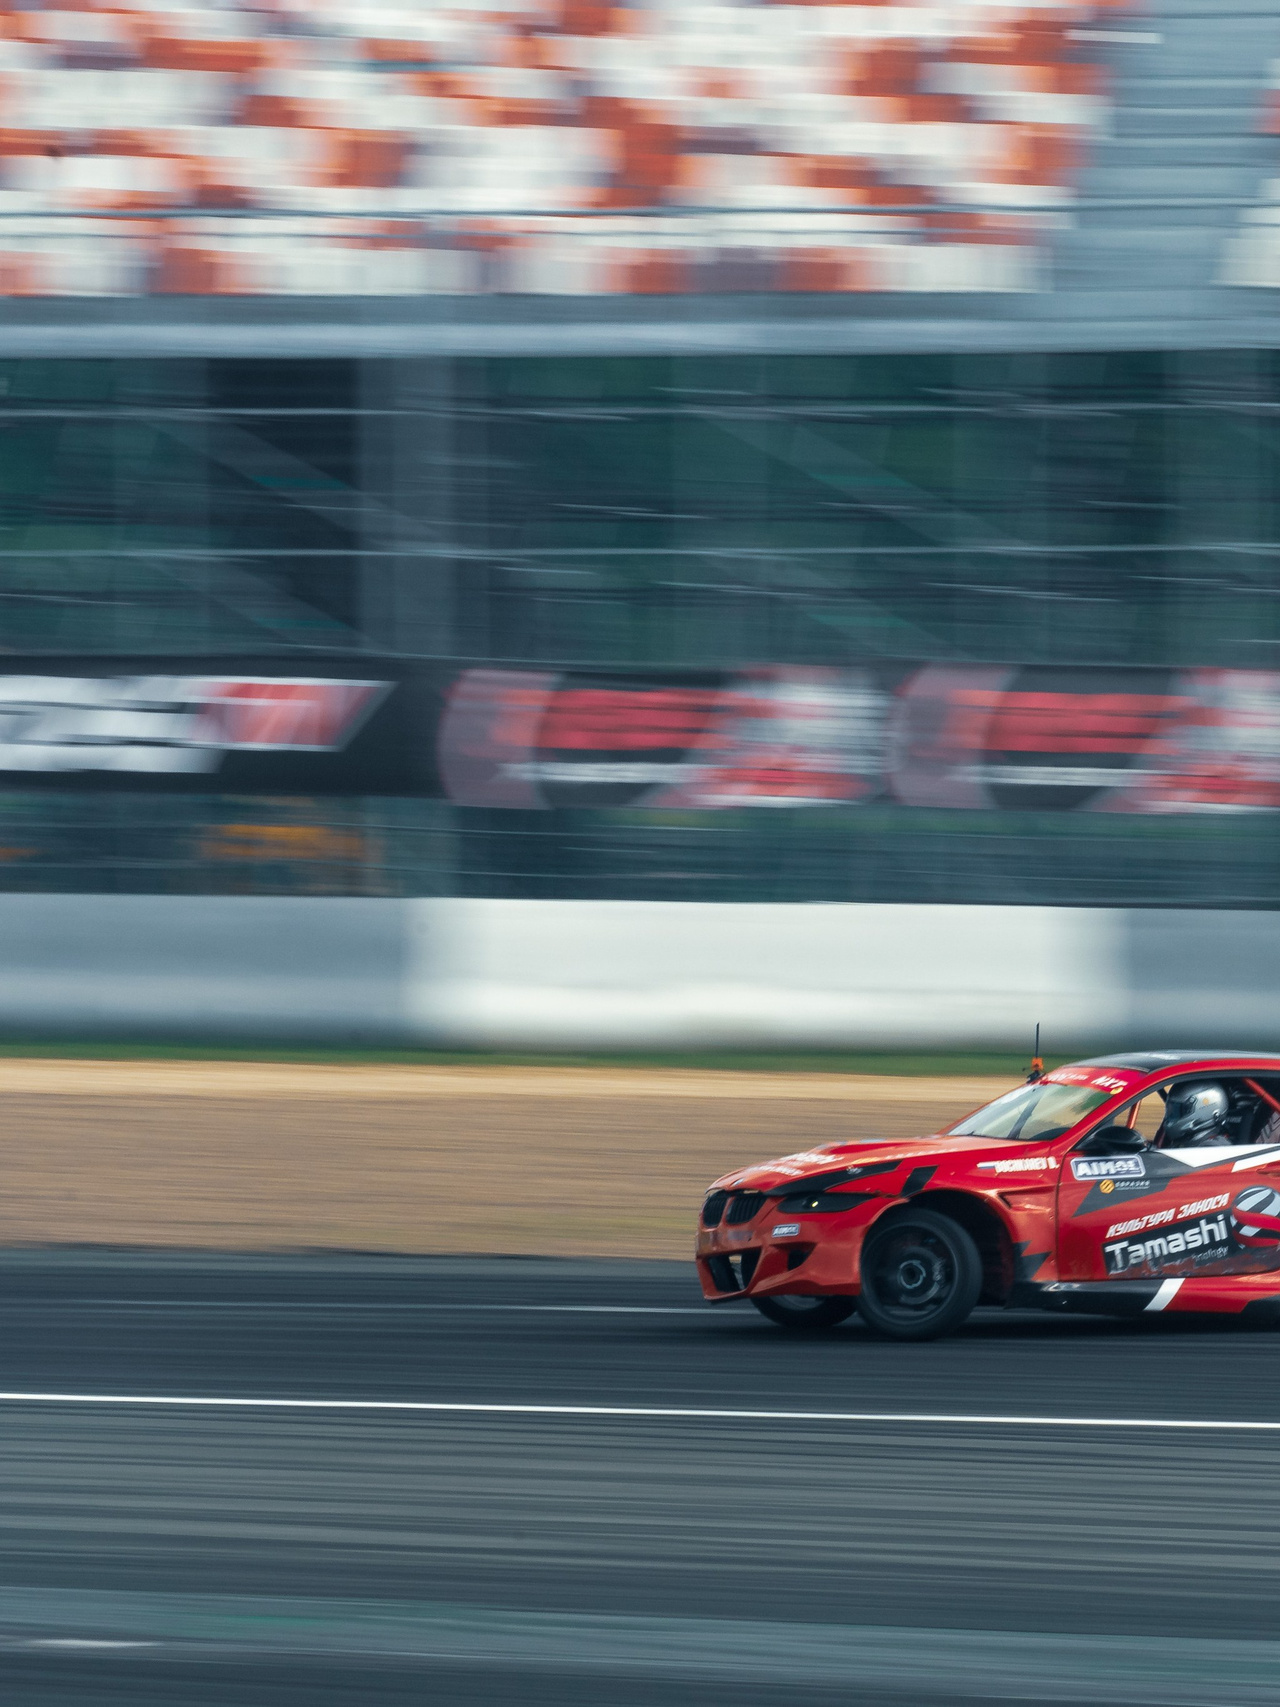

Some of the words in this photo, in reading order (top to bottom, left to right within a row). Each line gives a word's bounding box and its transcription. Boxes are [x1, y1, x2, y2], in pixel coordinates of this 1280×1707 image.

[1105, 1208, 1176, 1238] КУЛЬТУРА
[1177, 1192, 1230, 1219] ЗАНОСА
[1104, 1214, 1228, 1269] Tamashi
